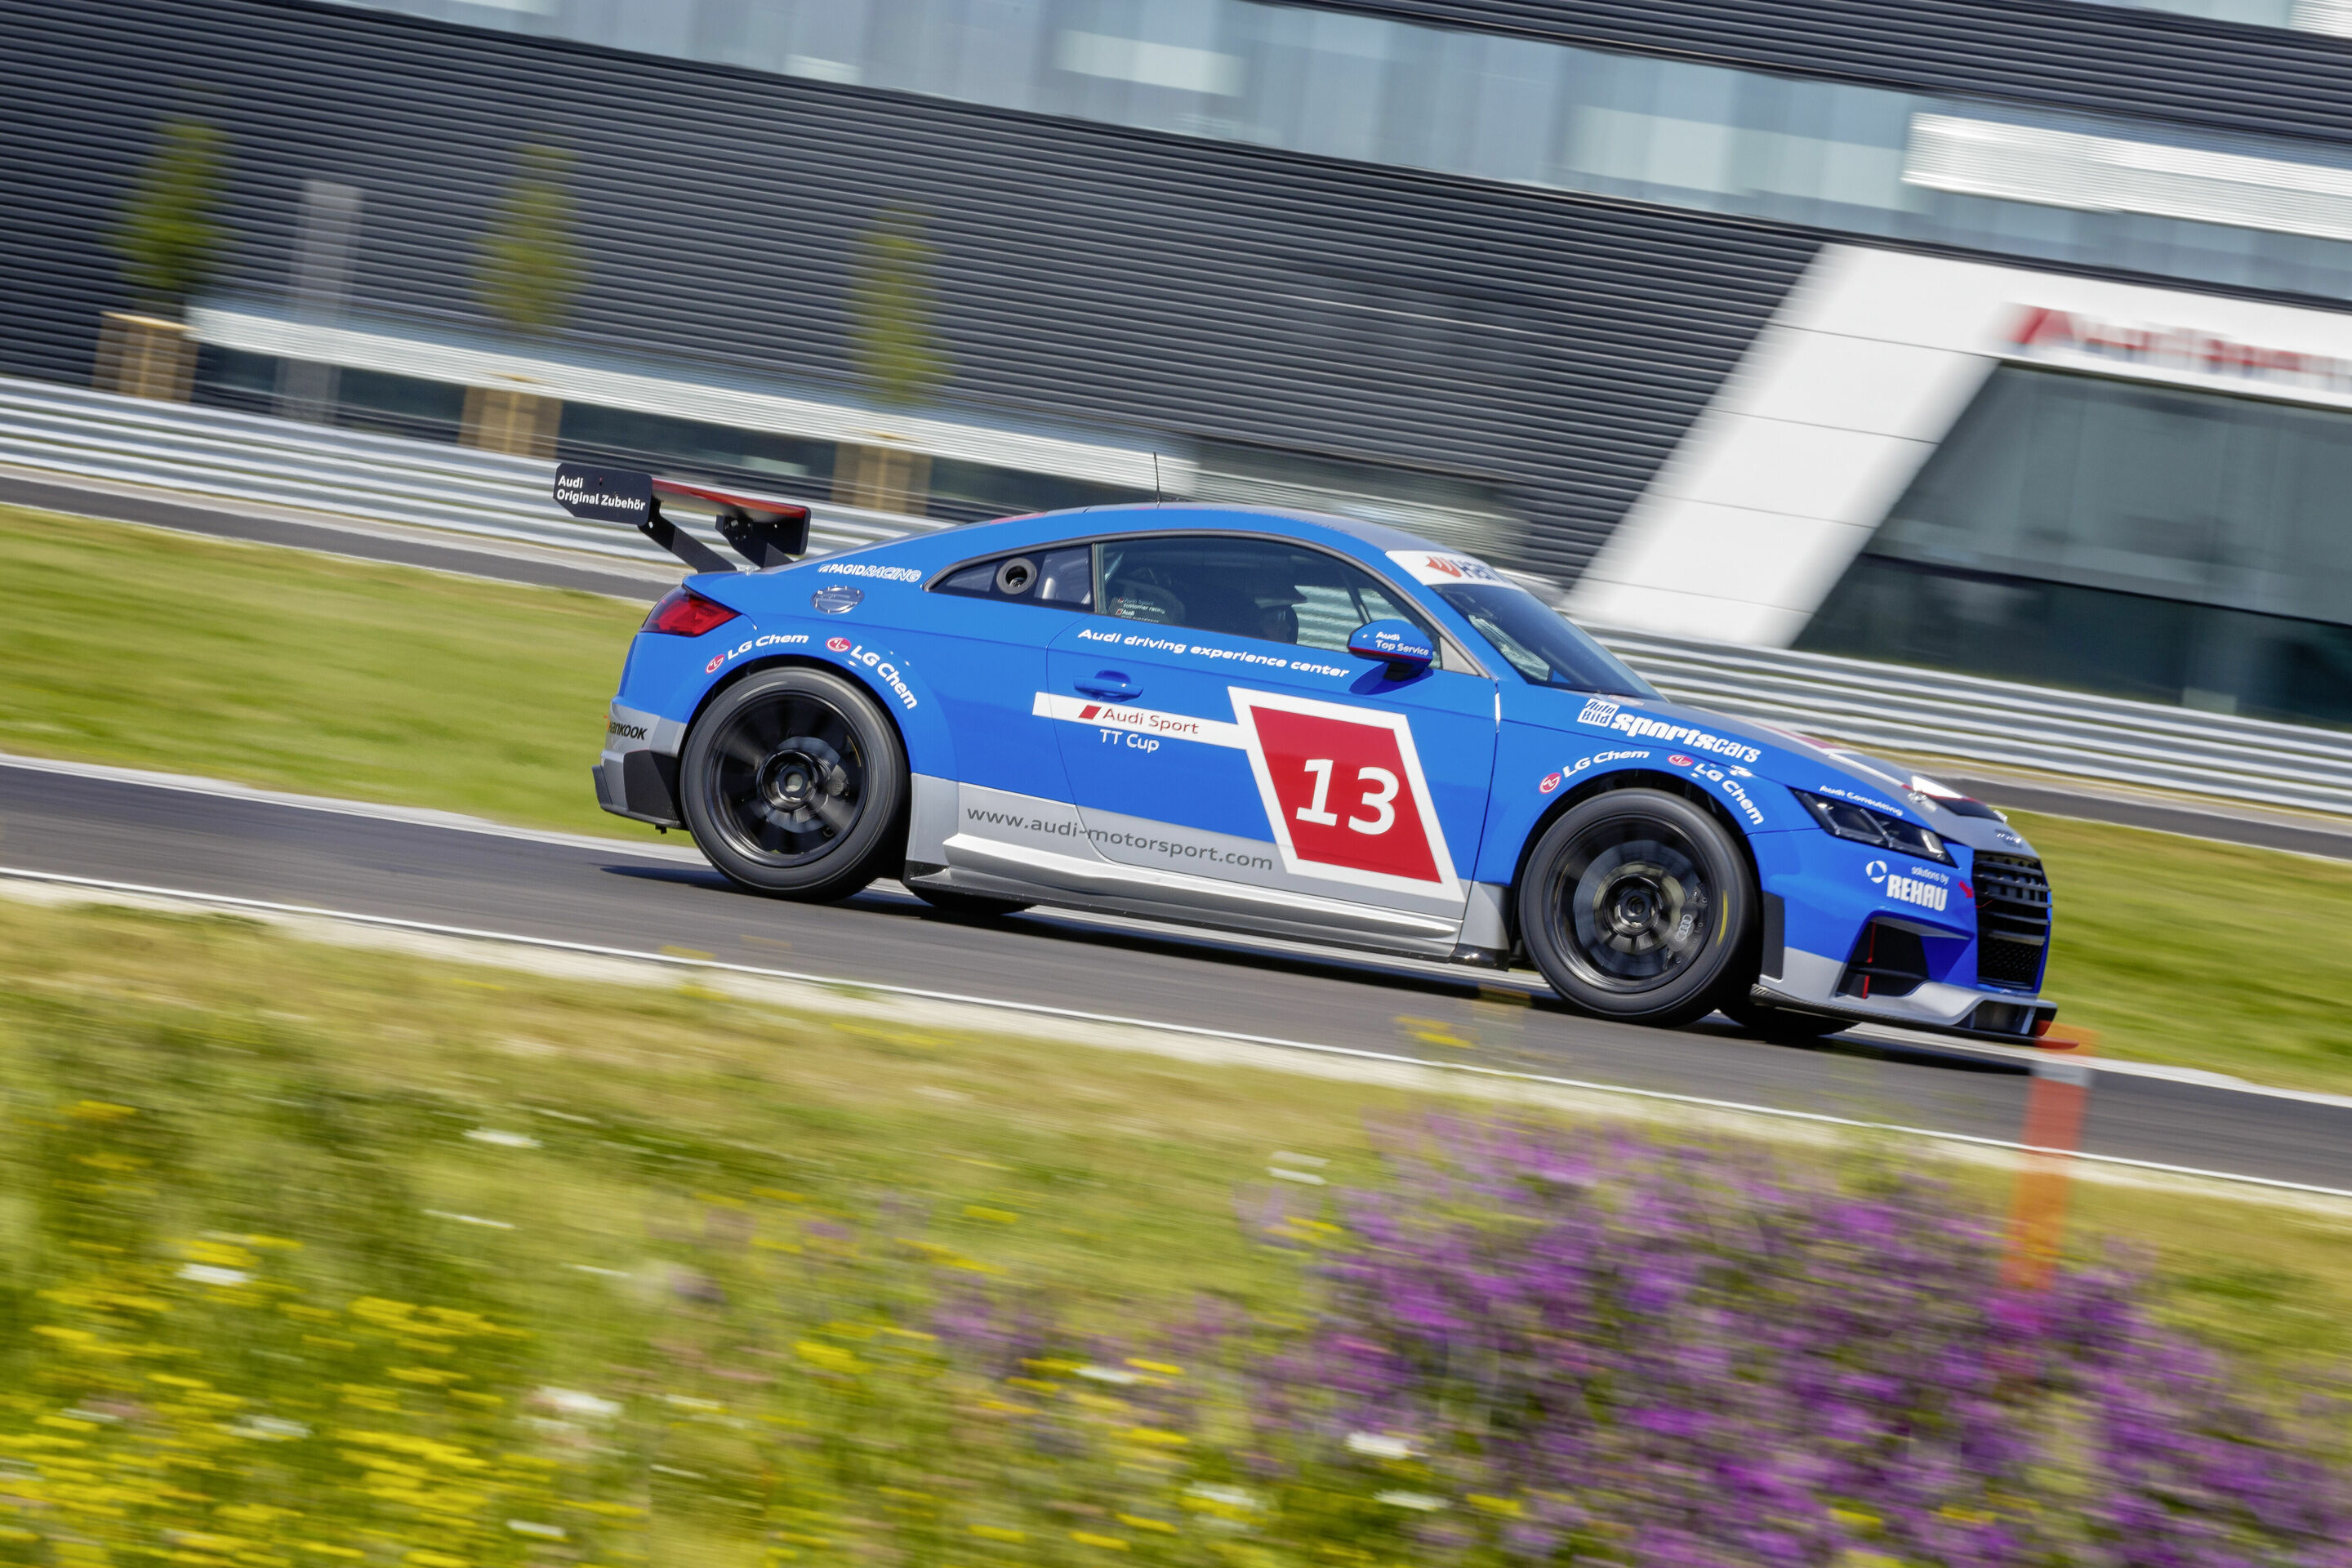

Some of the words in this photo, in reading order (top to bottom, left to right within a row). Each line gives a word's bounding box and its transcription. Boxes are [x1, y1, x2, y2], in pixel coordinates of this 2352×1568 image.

[558, 475, 583, 488] Audi
[557, 488, 599, 505] Original
[601, 494, 645, 511] Zubehör
[728, 640, 753, 660] LG
[755, 634, 808, 648] Chem
[1375, 631, 1400, 641] Audi
[1375, 639, 1395, 652] Top
[1397, 643, 1429, 656] Service
[1078, 629, 1122, 644] Audi
[1124, 635, 1186, 653] driving
[1190, 646, 1287, 668] experience
[1290, 661, 1350, 678] center
[851, 645, 880, 666] LG
[877, 663, 918, 710] Chem
[1102, 708, 1144, 725] Audi
[1148, 715, 1199, 734] Sport
[1099, 728, 1123, 745] TT
[1126, 733, 1160, 753] Cup
[1610, 714, 1762, 763] sportscars
[1562, 757, 1591, 777] LG
[1593, 750, 1650, 764] Chem
[1296, 759, 1400, 835] 13
[1694, 763, 1725, 782] LG
[1722, 779, 1764, 826] Chem
[967, 806, 1272, 871] www.audi-motorsport.com
[1940, 873, 1949, 885] by
[1886, 874, 1948, 911] REHAU
